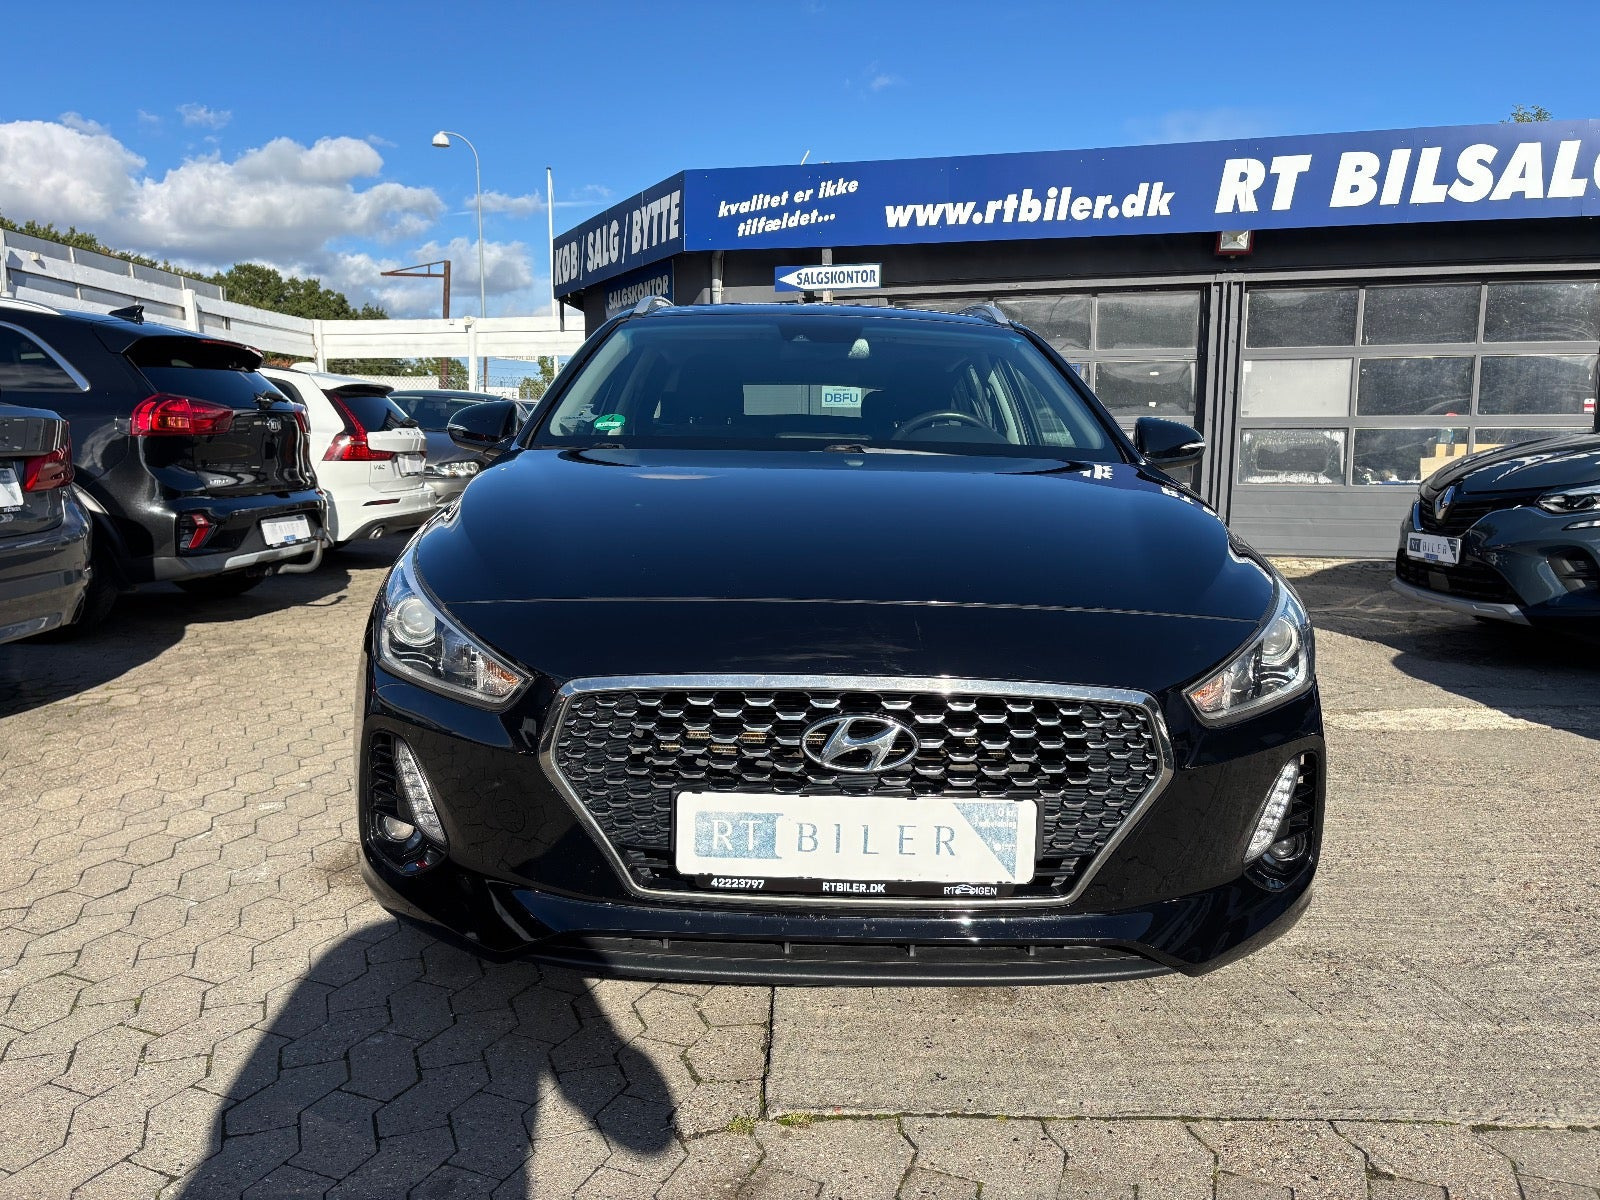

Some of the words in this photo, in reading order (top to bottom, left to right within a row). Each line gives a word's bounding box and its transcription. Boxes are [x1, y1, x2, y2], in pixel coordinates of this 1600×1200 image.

[1214, 154, 1313, 214] RT
[1329, 139, 1600, 208] BILSAL
[718, 191, 789, 218] kvalitet
[793, 188, 813, 203] er
[818, 178, 859, 199] ikke
[885, 181, 1176, 228] www.rtbiler.dk
[554, 241, 578, 287] KØB
[586, 219, 620, 273] SALG
[631, 190, 681, 255] BYTTE
[737, 209, 836, 237] tilfældet...
[608, 274, 669, 310] SALGSKONTOR
[796, 269, 876, 286] SALGSKONTOR
[824, 392, 859, 403] DBFU
[710, 818, 760, 852] RT
[796, 822, 956, 857] BILER
[710, 878, 765, 889] 42223797
[822, 881, 886, 893] RTBILER.DK
